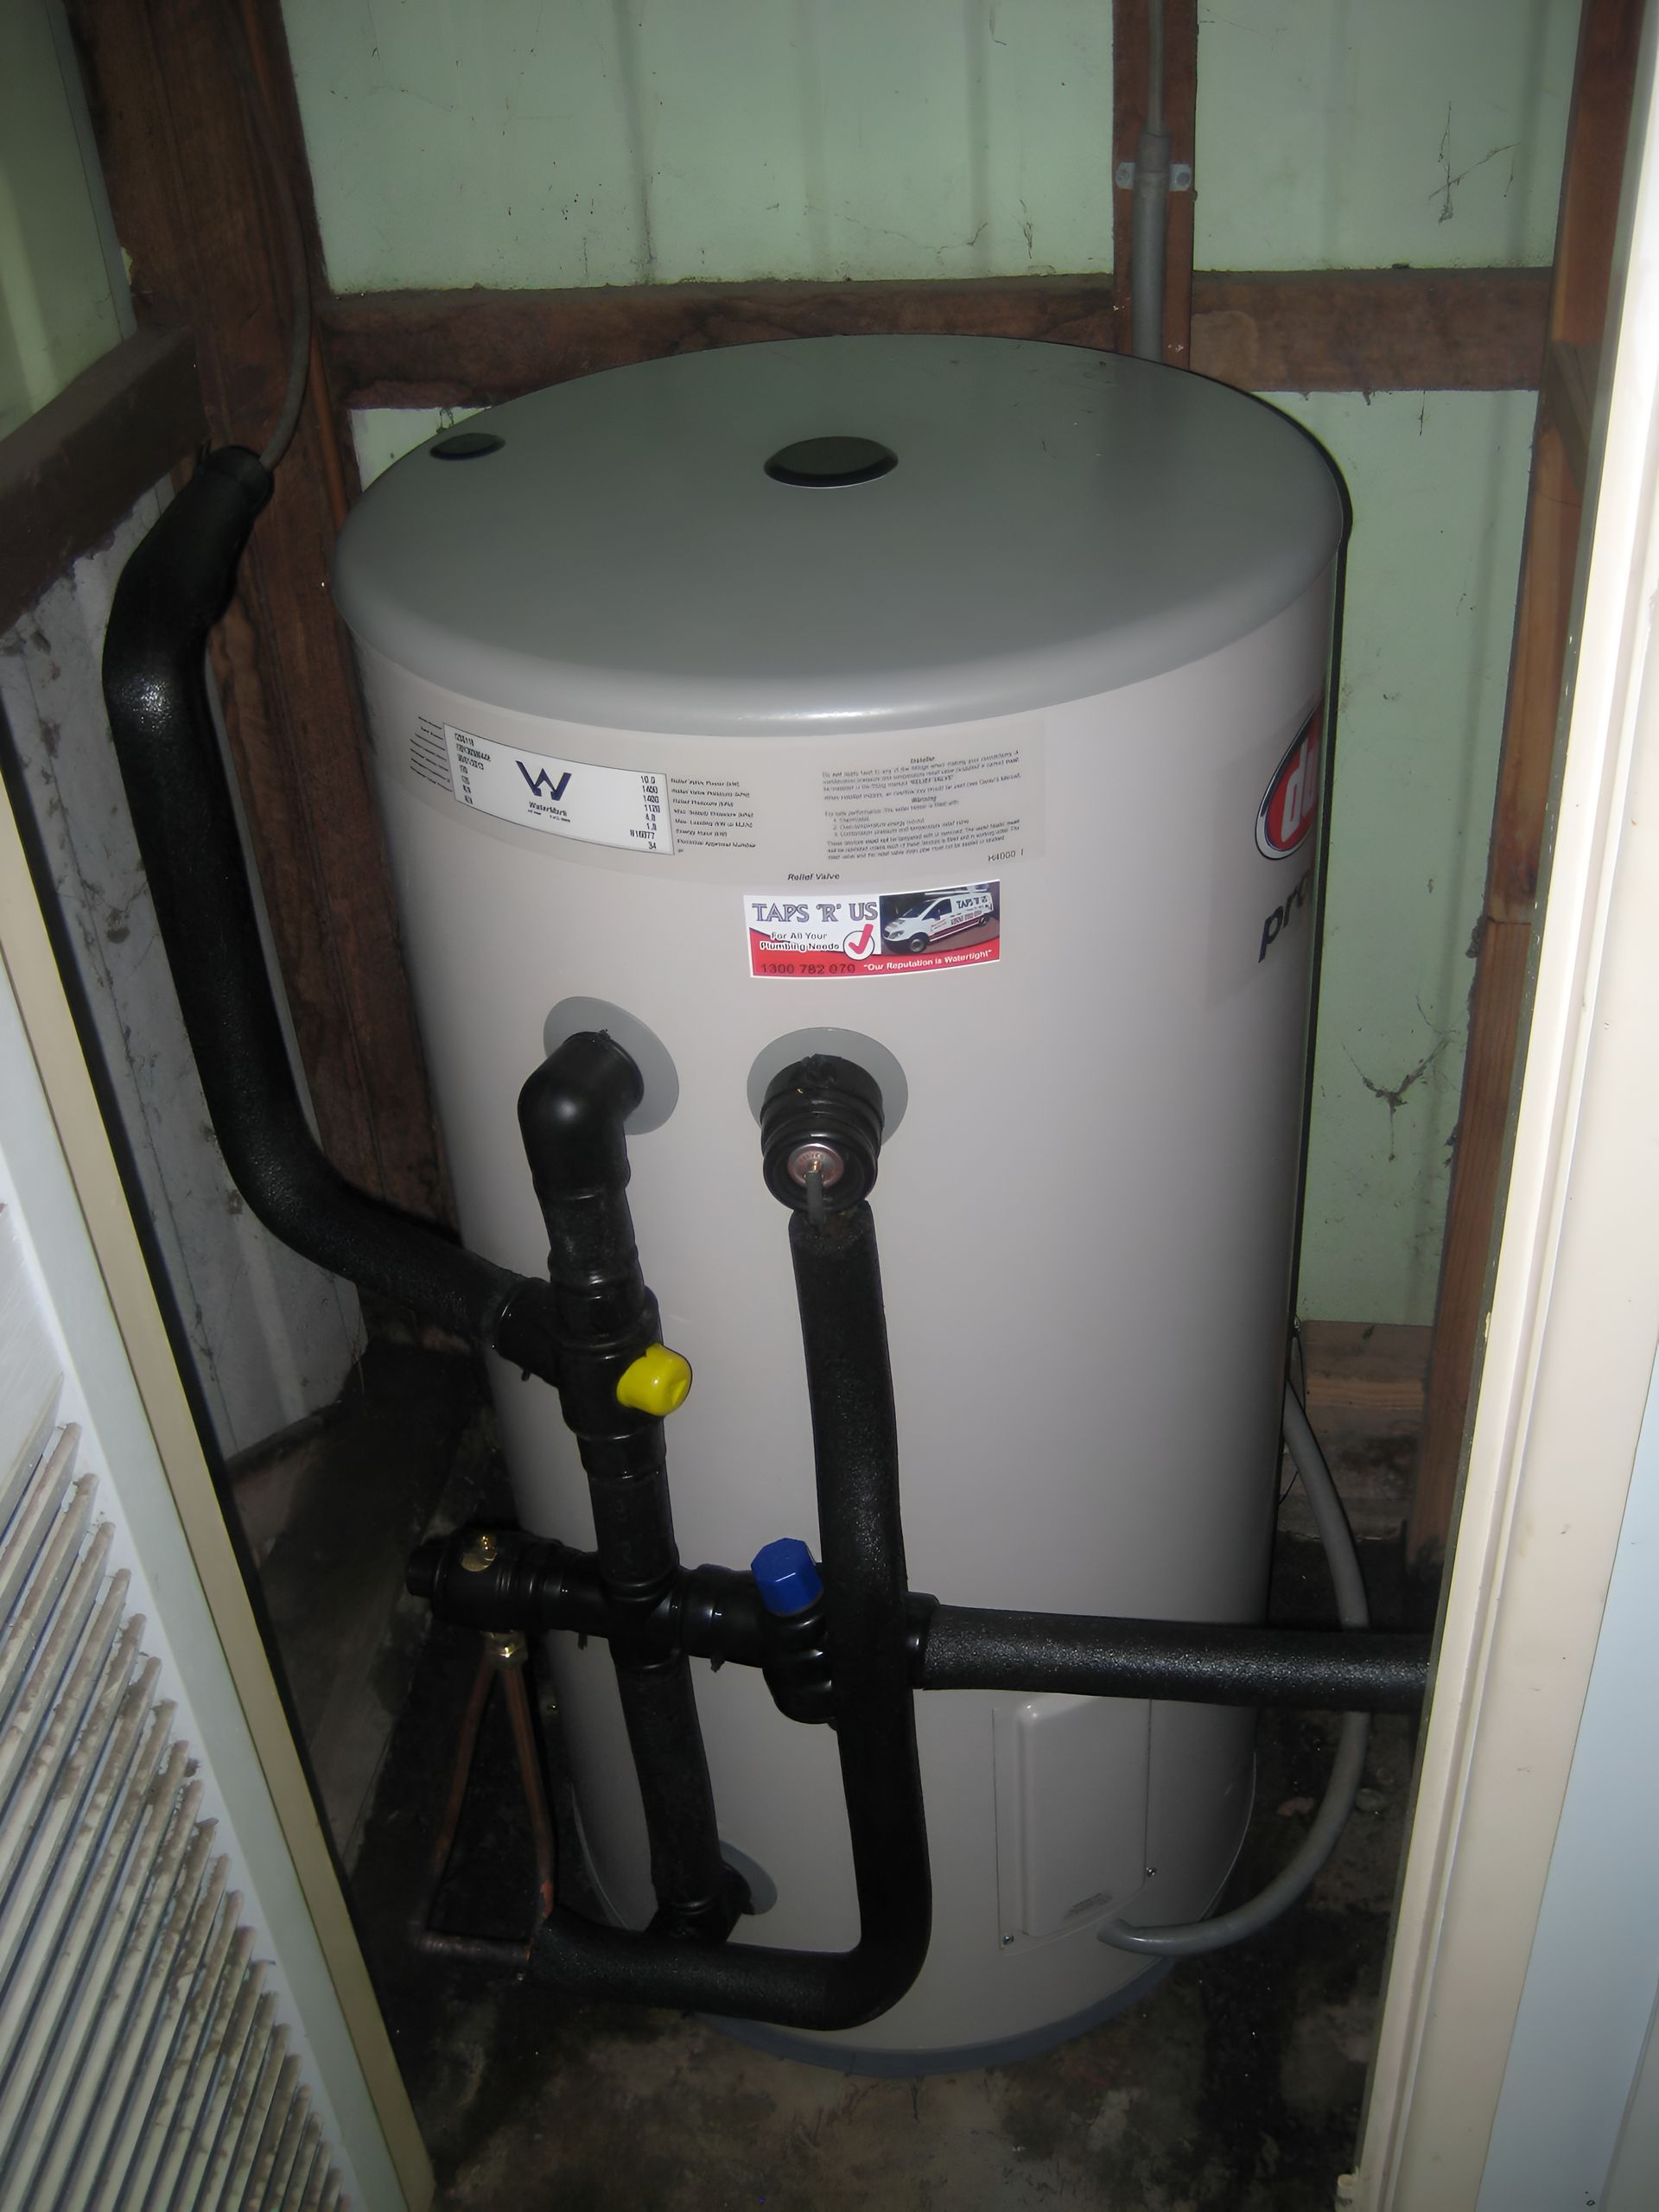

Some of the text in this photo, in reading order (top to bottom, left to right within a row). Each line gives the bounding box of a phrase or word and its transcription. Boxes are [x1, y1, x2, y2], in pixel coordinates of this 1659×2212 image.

[752, 903, 810, 923] TAPS
[849, 901, 879, 921] US
[760, 942, 805, 951] Plumbing
[762, 963, 855, 975] 1300 782 070
[887, 959, 933, 969] Reputation
